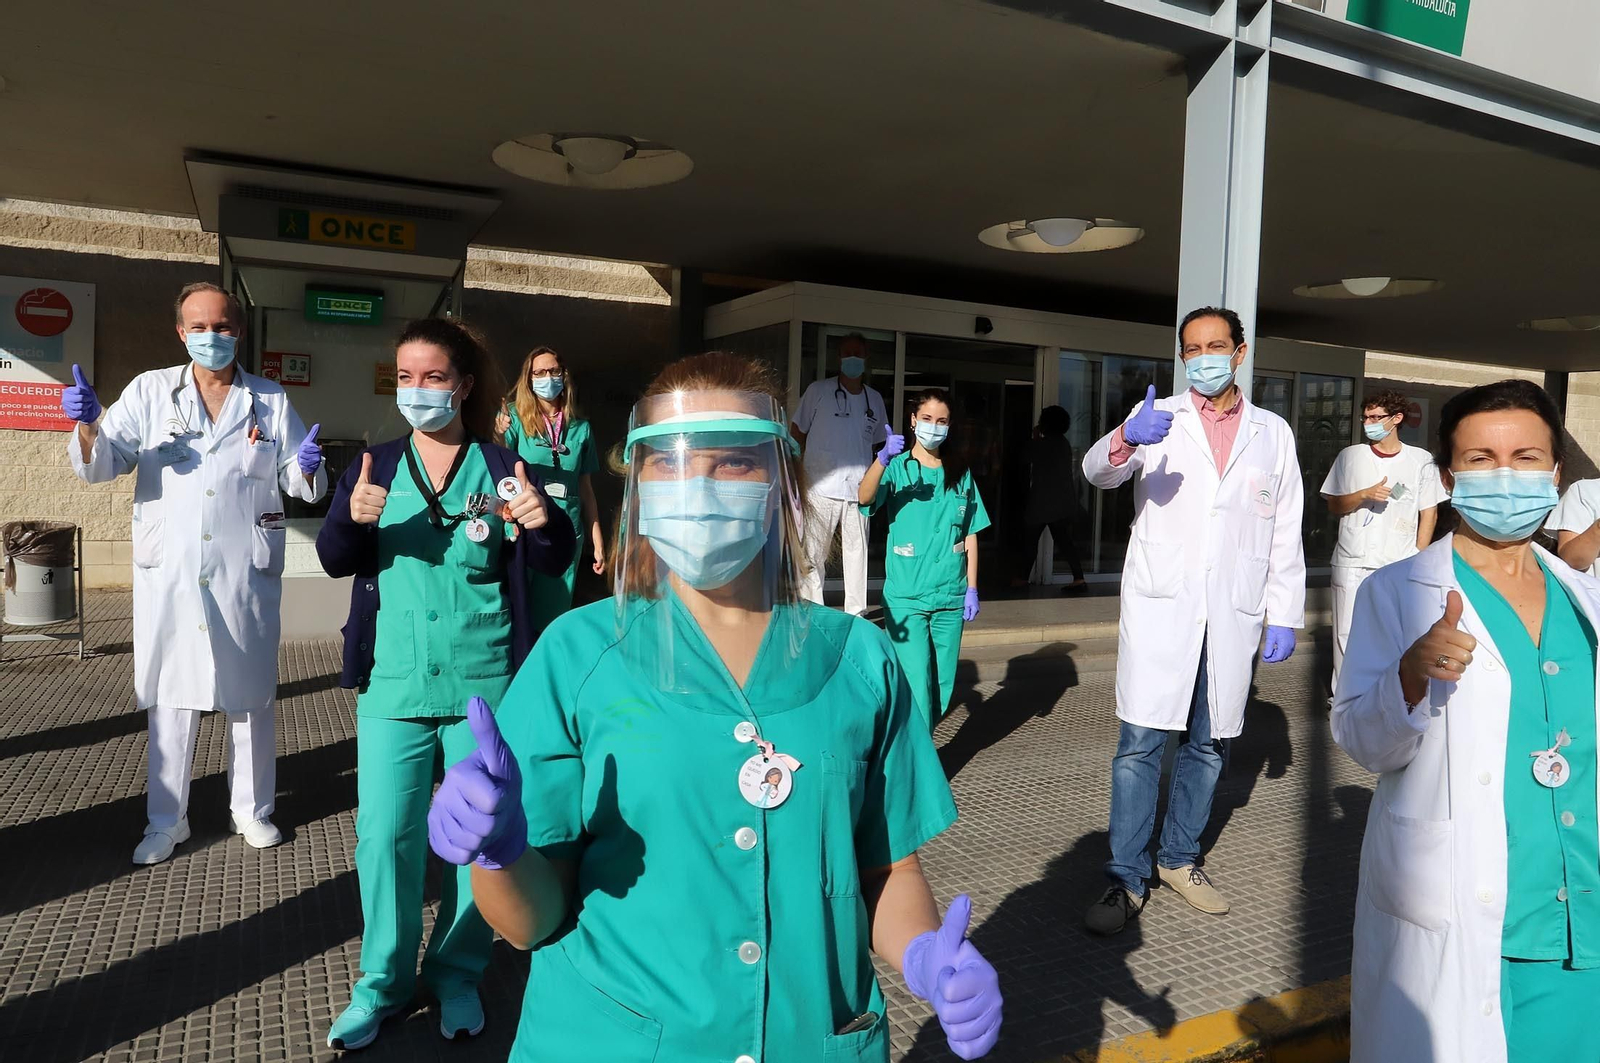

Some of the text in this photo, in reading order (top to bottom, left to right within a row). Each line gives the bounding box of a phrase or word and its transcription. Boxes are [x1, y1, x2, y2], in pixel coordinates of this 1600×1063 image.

[321, 217, 404, 244] ONCE
[333, 301, 370, 311] ONCE
[263, 360, 281, 368] BOTE
